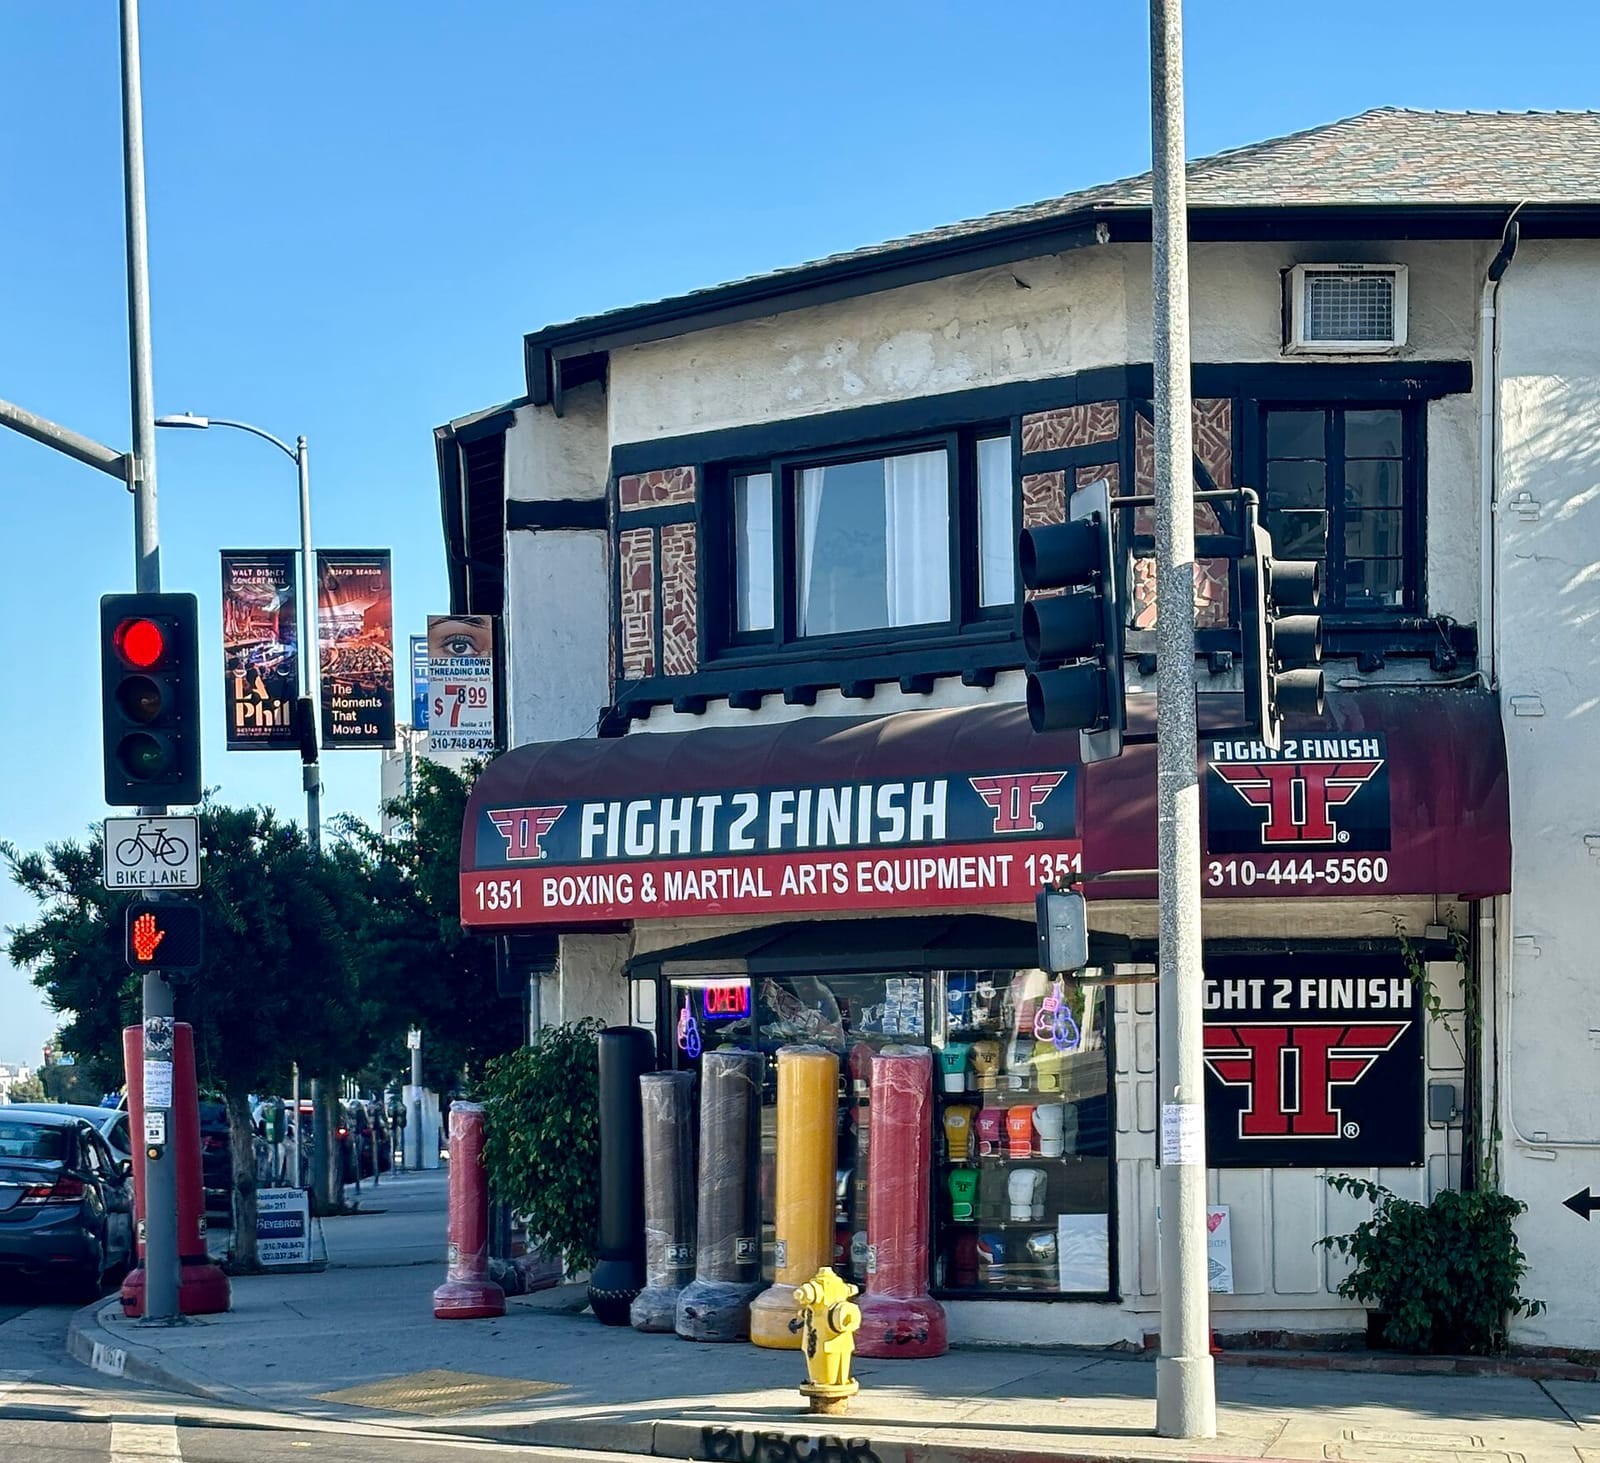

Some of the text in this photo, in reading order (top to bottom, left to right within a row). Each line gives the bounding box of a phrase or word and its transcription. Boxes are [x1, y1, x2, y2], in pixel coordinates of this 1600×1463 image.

[232, 577, 285, 585] CONCERT HALL
[430, 658, 491, 667] JAZZ EYEBROWS
[430, 667, 490, 676] THREADING BAR
[235, 677, 269, 700] LA
[331, 683, 352, 695] The
[332, 697, 382, 708] Moments
[236, 700, 290, 726] Phil
[331, 710, 357, 721] That
[332, 723, 378, 735] Move Us
[1284, 739, 1298, 759] 2
[1302, 738, 1380, 759] FINISH
[580, 780, 948, 858] FIGHT 2 FINISH
[116, 869, 188, 884] BIKE LANE
[1208, 857, 1388, 887] 310-444-5560
[475, 879, 522, 911] 1351
[543, 874, 633, 907] BOXING
[641, 872, 657, 903] &
[664, 867, 772, 901] MARTIAL
[780, 862, 849, 897] ARTS
[857, 855, 1014, 894] EQUIPMENT
[706, 985, 746, 1013] OPEN
[1272, 978, 1293, 1009] 2
[1300, 978, 1413, 1009] FINISH
